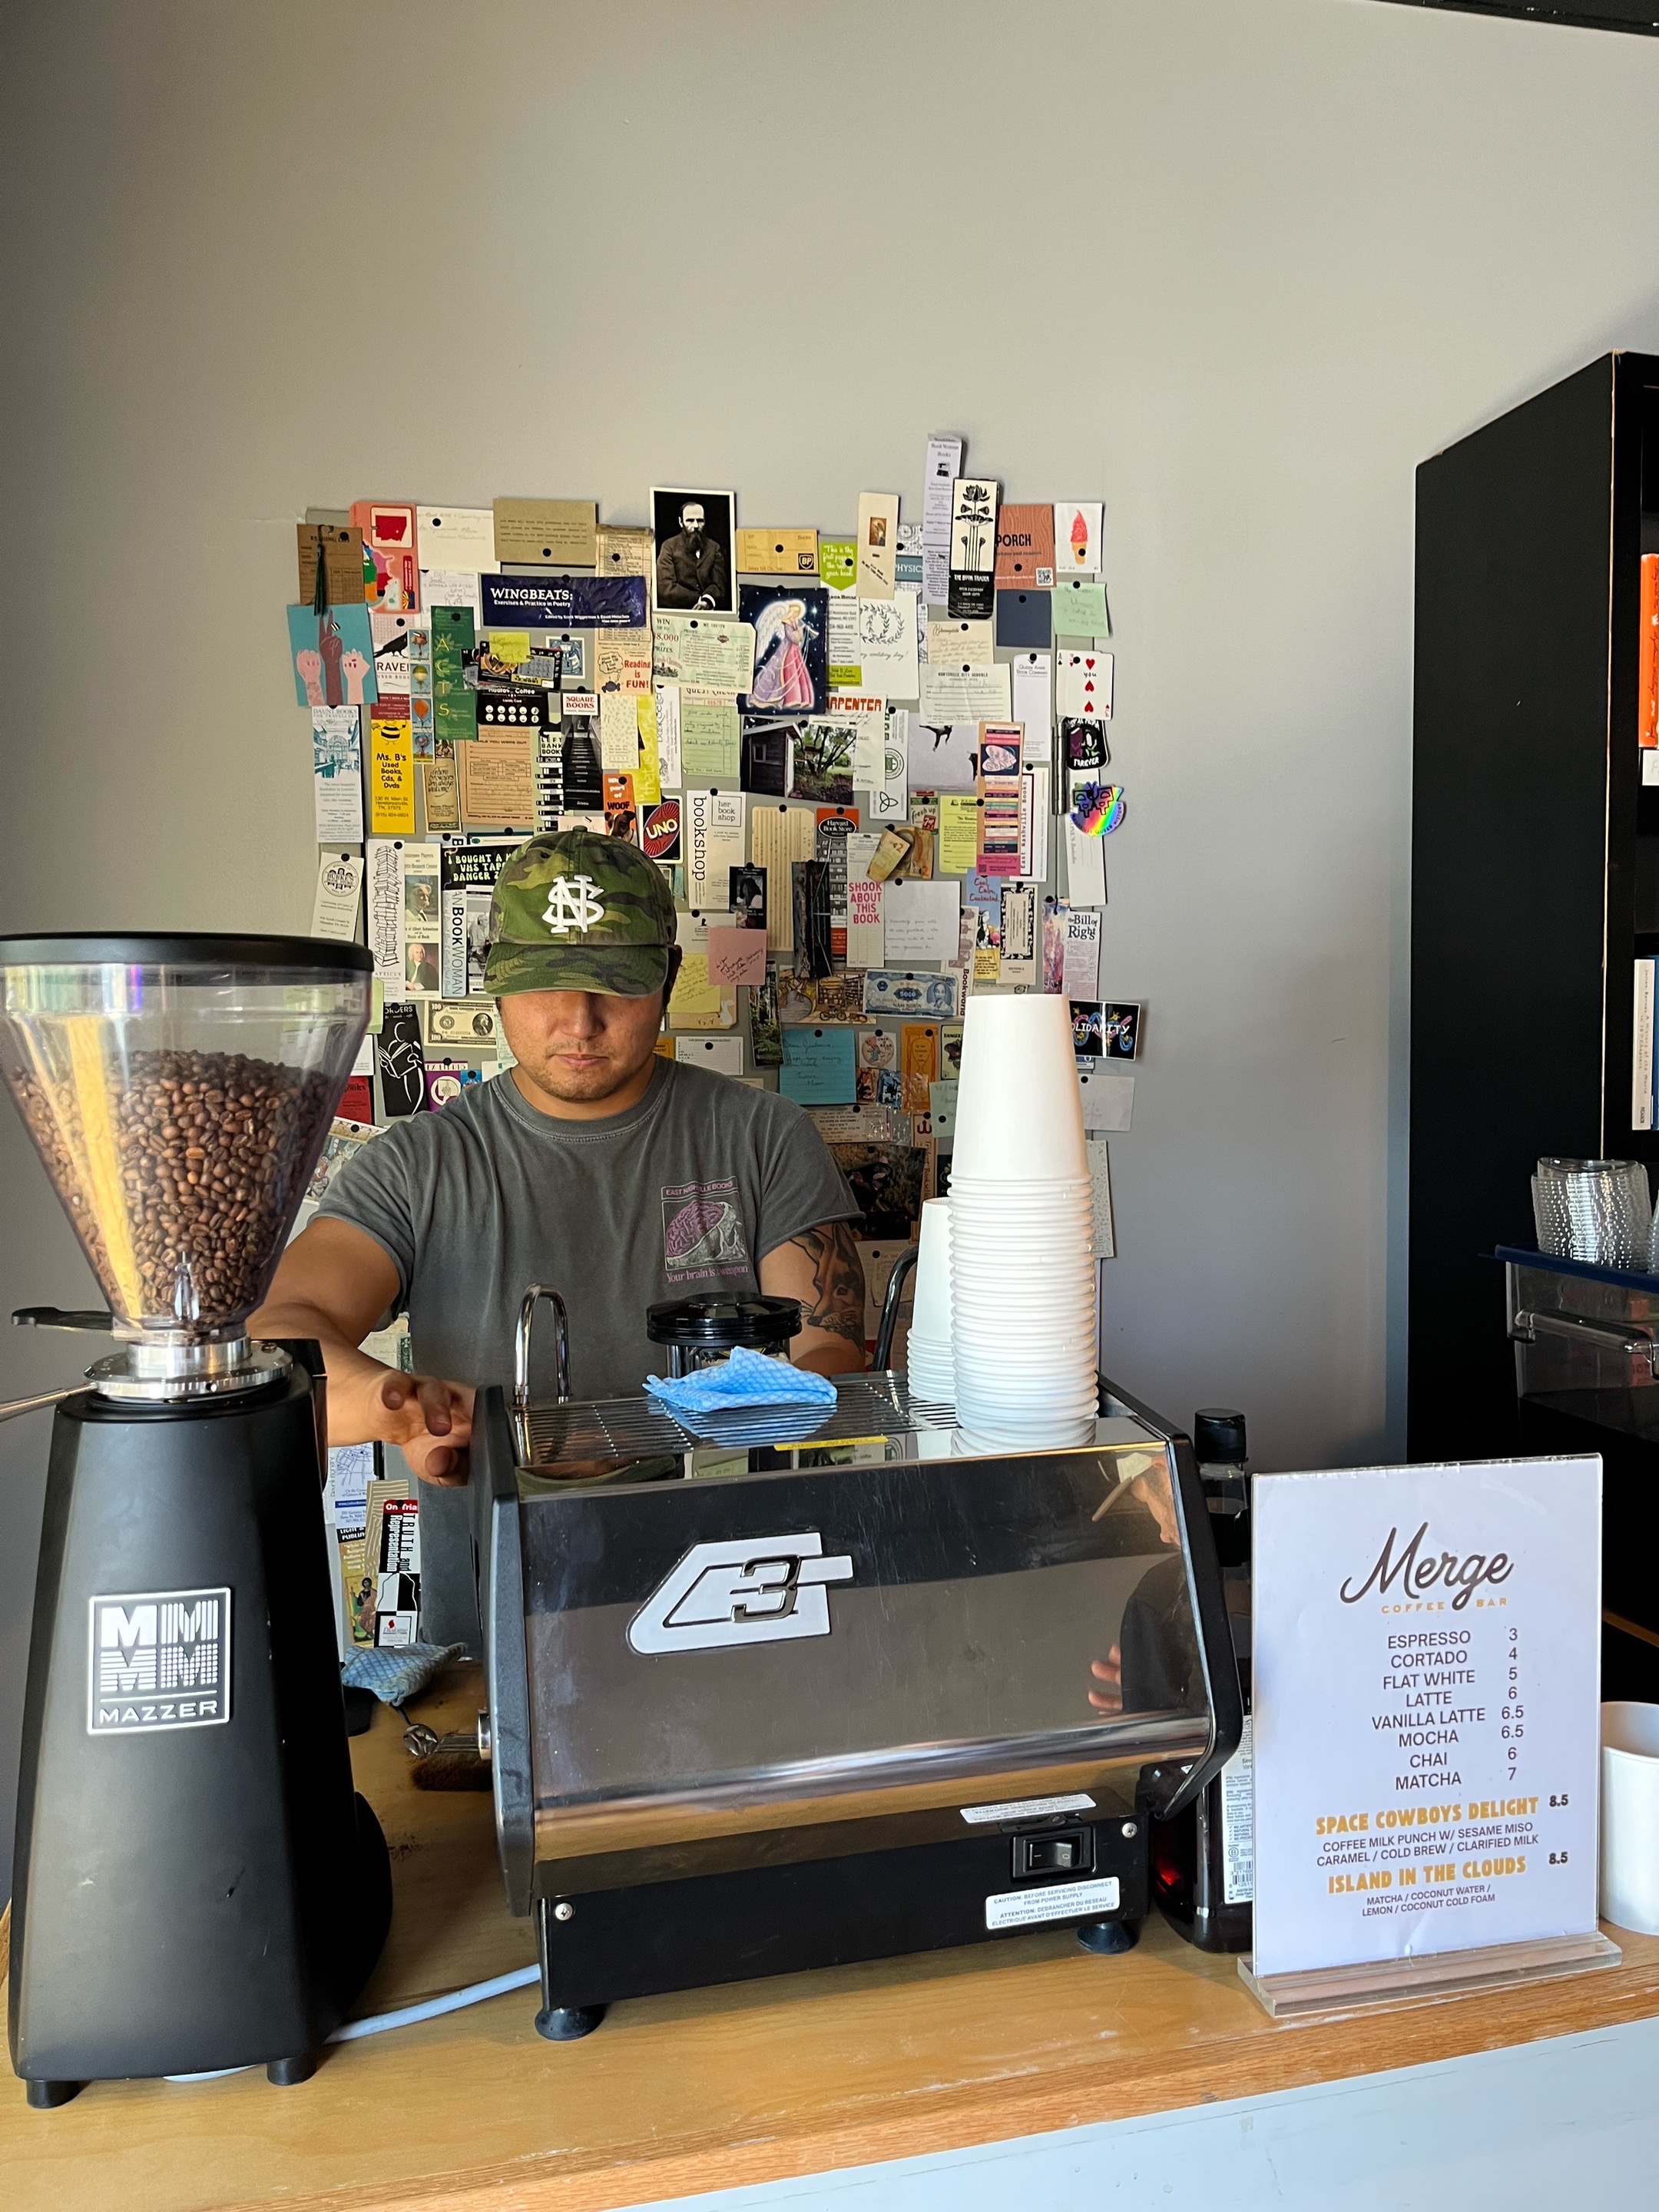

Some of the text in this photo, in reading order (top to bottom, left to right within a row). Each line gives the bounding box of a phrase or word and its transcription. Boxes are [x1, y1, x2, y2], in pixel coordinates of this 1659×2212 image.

[490, 588, 573, 601] WINGBEATS:
[624, 660, 651, 668] Reading
[634, 670, 641, 678] is
[376, 753, 391, 761] Ms.
[1074, 757, 1099, 767] FOREVER
[608, 801, 630, 810] WOOF
[912, 807, 927, 824] fresh
[645, 819, 677, 839] UNO
[692, 796, 707, 881] bookshop
[455, 854, 492, 864] BOUGHT
[459, 863, 479, 873] VHS
[453, 872, 490, 882] DANGER
[849, 882, 882, 892] SHOOK
[850, 892, 882, 902] ABOUT
[856, 903, 876, 913] THIS
[853, 914, 880, 924] BOOK
[1074, 914, 1091, 925] Bill
[1068, 925, 1096, 940] Rights
[452, 907, 464, 995] BOOKWOMAN
[667, 1273, 686, 1283] Your
[687, 1269, 707, 1280] brain
[386, 1515, 403, 1572] Representation
[399, 1513, 416, 1571] TRUTH and
[1339, 1522, 1515, 1611] Merge
[1381, 1597, 1508, 1614] COFFEE BAR
[1388, 1628, 1518, 1649] ESPRESSO 3
[1391, 1647, 1518, 1668] CORTADO 4
[1383, 1667, 1517, 1690] FLAT WHITE 5
[1406, 1686, 1517, 1707] LATTE 6
[100, 1700, 217, 1724] MAZZER
[1372, 1705, 1524, 1730] VANILLA LATTE 6.5
[1399, 1724, 1524, 1747] MOCHA 6.5
[1409, 1747, 1517, 1768] CHAI 6
[1396, 1767, 1517, 1790] MATCHA 7
[1316, 1794, 1569, 1836] SPACE COWBOYS DELIGHT 8.5
[1323, 1822, 1533, 1853] COFFEE MILK PUNCH W/ SESAME MISO
[1316, 1834, 1539, 1866] CARAMEL COLD BREW CLARIFIED MILK
[1328, 1851, 1568, 1894] ISLAND IN THE CLOUDS 8.5
[1048, 1887, 1076, 1896] SERVICING
[1077, 1881, 1112, 1892] DISCONNECT
[1366, 1886, 1485, 1906] MATCHA COCONUT WATER
[1362, 1893, 1495, 1916] LEMON COCONUT COLD FOAM
